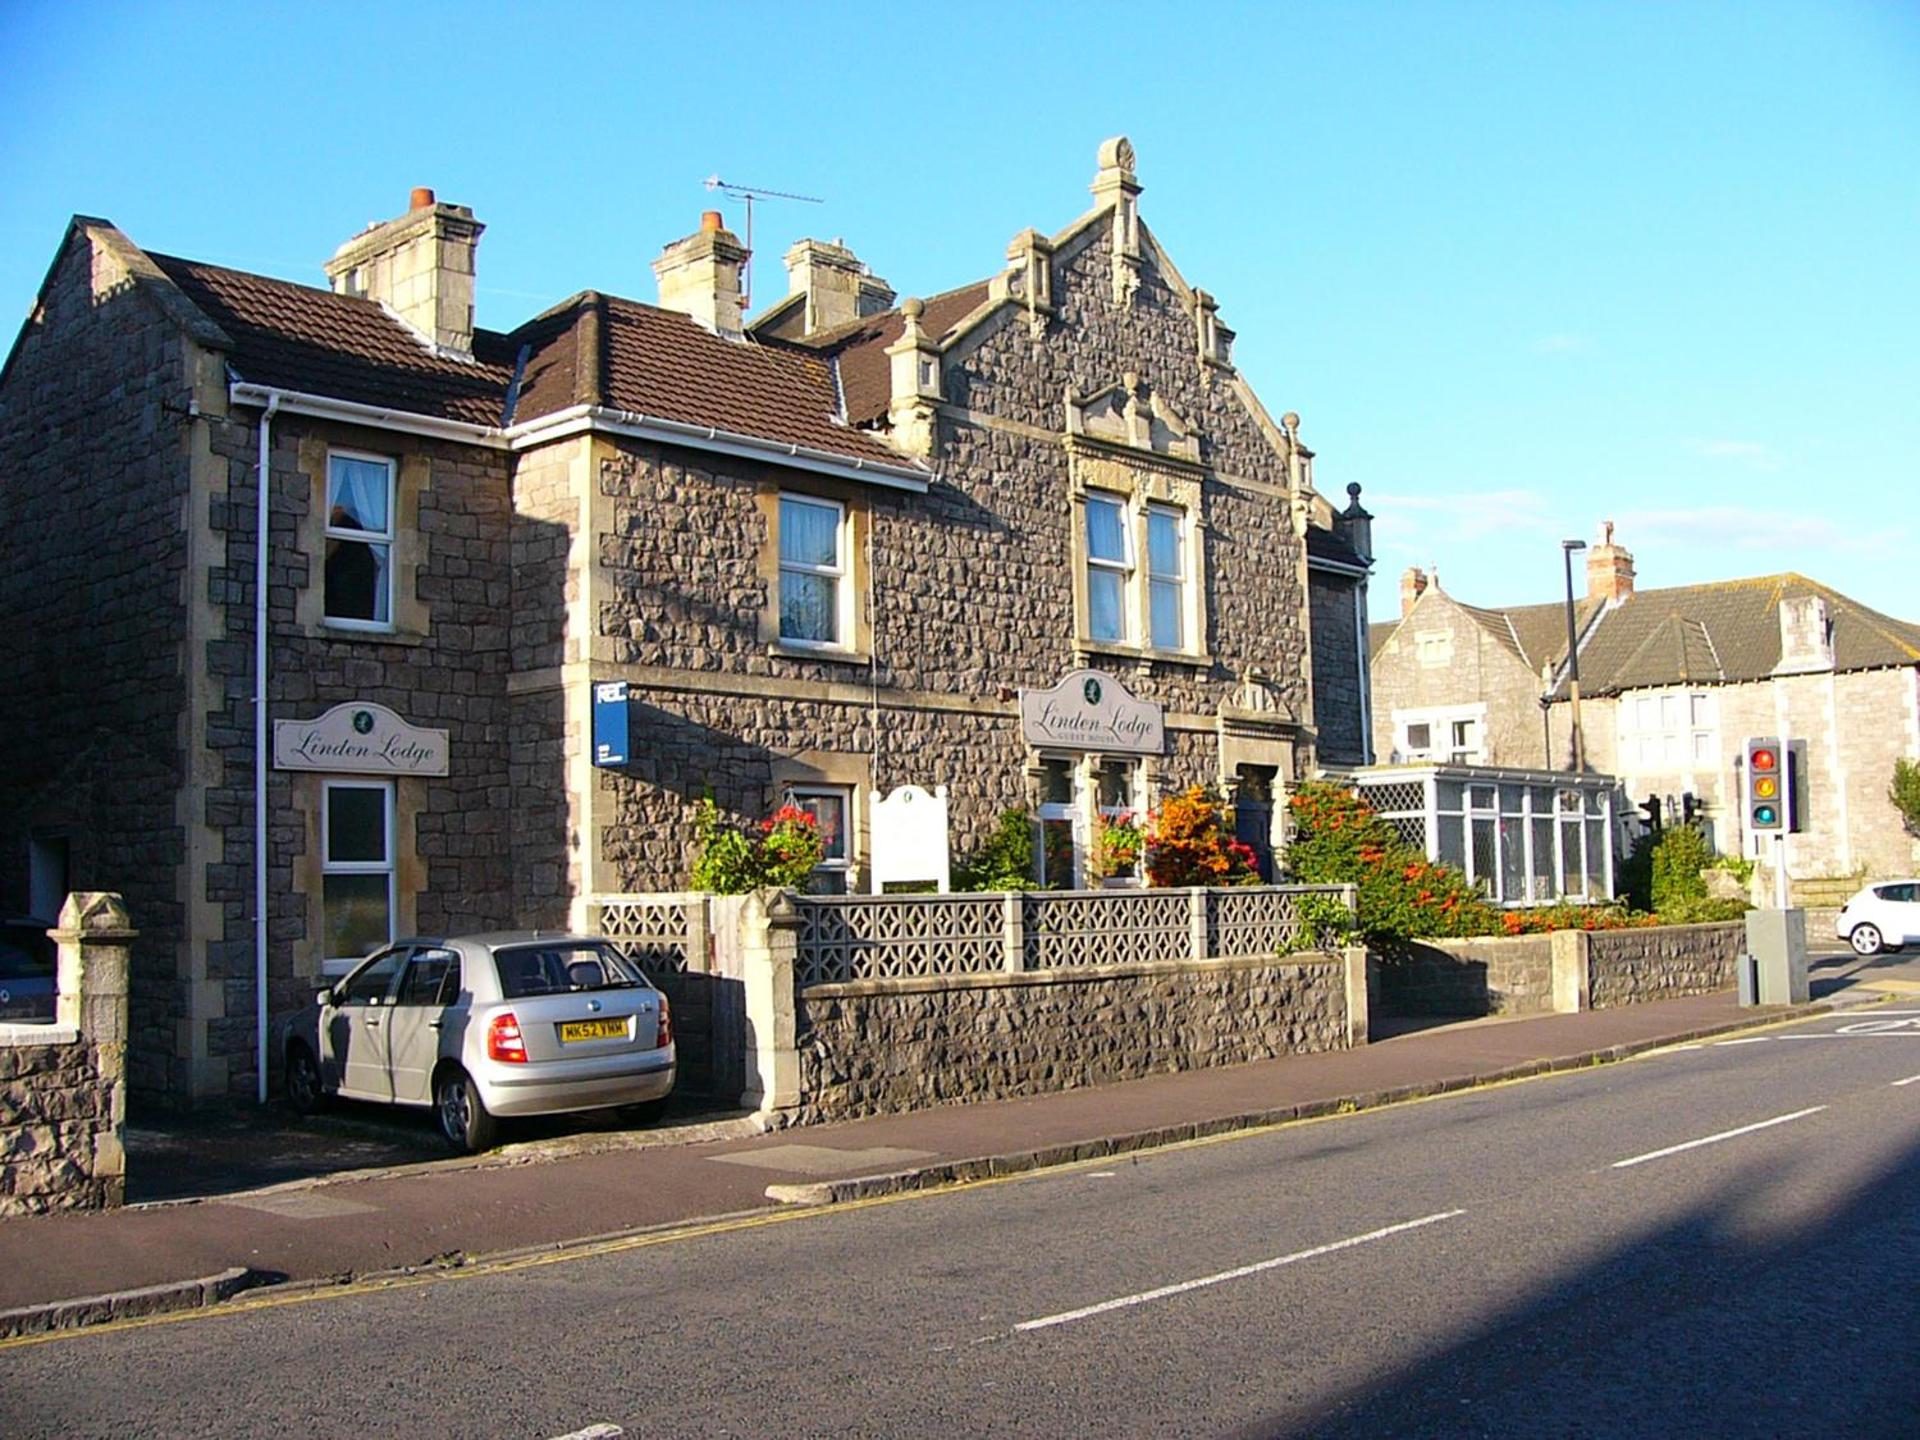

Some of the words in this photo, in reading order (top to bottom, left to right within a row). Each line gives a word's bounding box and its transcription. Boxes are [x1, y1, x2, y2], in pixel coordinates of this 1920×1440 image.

[1033, 698, 1100, 738] Linden
[1104, 703, 1154, 745] Lodge
[291, 729, 368, 764] Linden
[375, 733, 435, 769] Lodge
